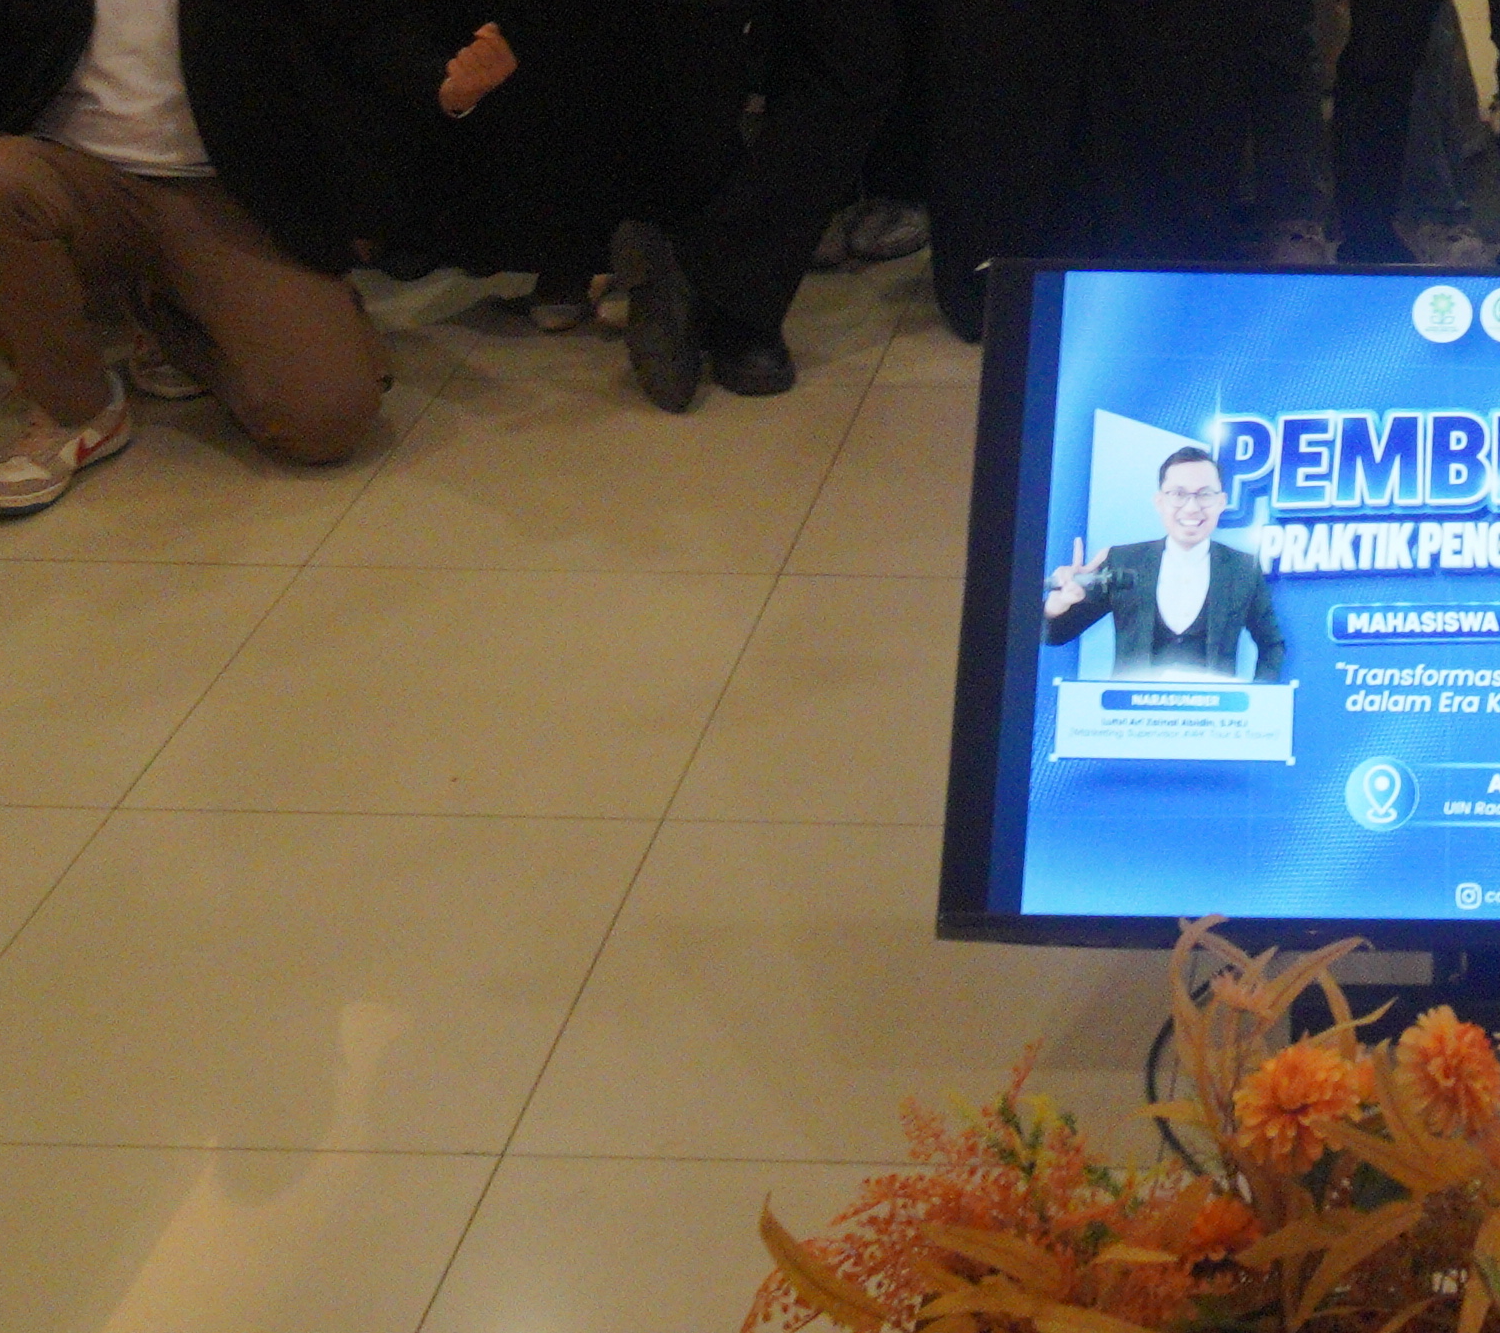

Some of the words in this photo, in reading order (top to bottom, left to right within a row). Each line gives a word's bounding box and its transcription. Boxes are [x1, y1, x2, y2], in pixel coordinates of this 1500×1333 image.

[1261, 521, 1416, 575] PRAKTIK
[1347, 612, 1500, 634] MAHASISWA
[1345, 690, 1432, 712] dalam
[1439, 692, 1481, 714] Era
[1444, 802, 1471, 815] UIN
